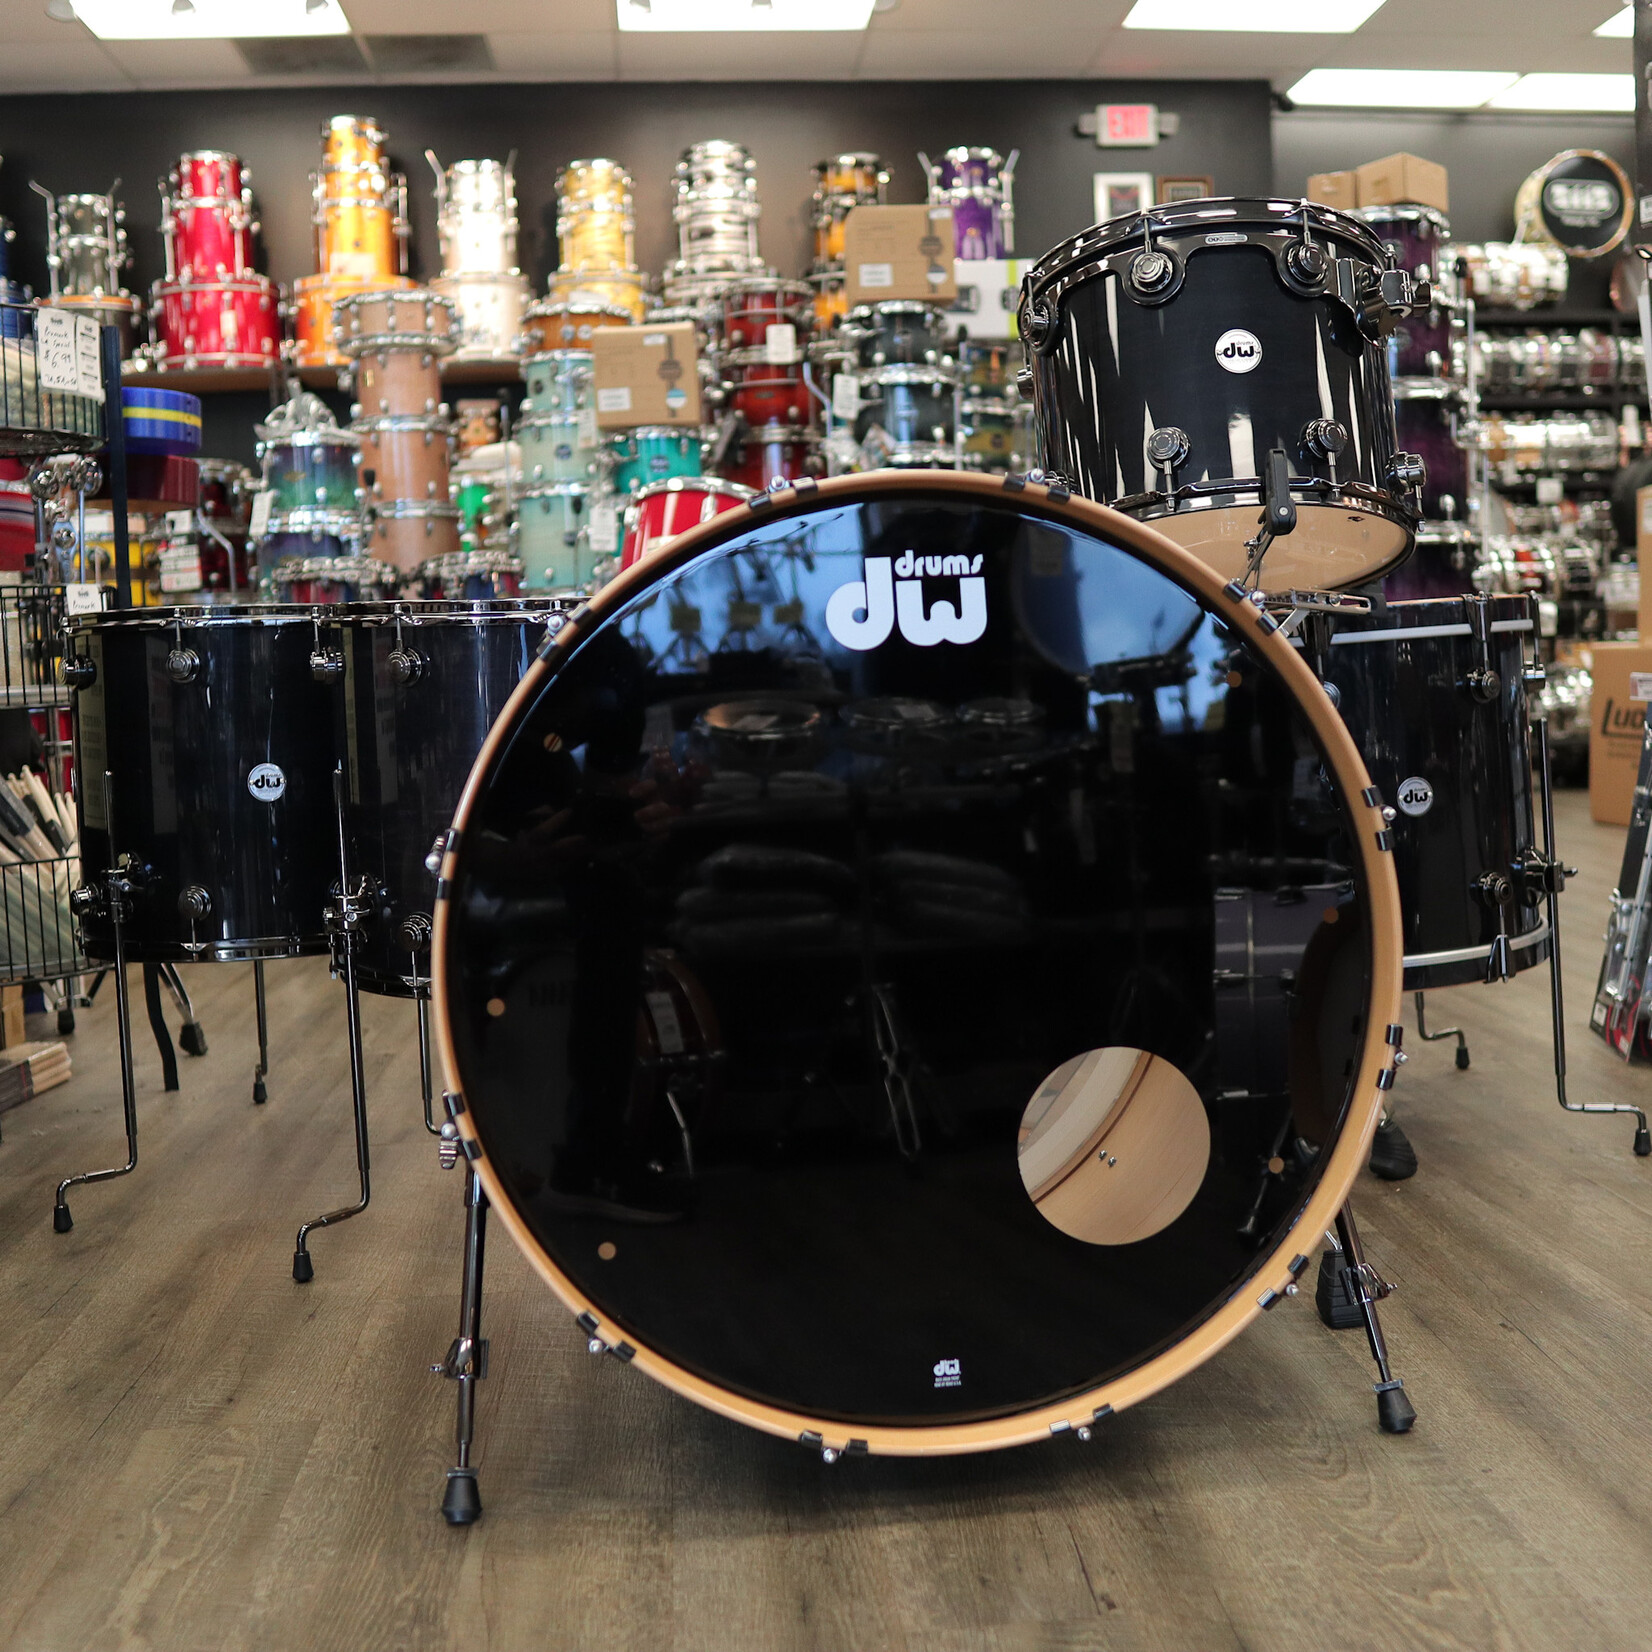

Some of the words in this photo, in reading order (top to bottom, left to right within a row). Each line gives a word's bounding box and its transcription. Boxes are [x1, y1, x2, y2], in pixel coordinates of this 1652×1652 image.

[1223, 342, 1254, 358] dw
[895, 549, 984, 577] drums
[825, 556, 988, 651] dw
[254, 774, 281, 789] dw
[1403, 789, 1428, 804] dw
